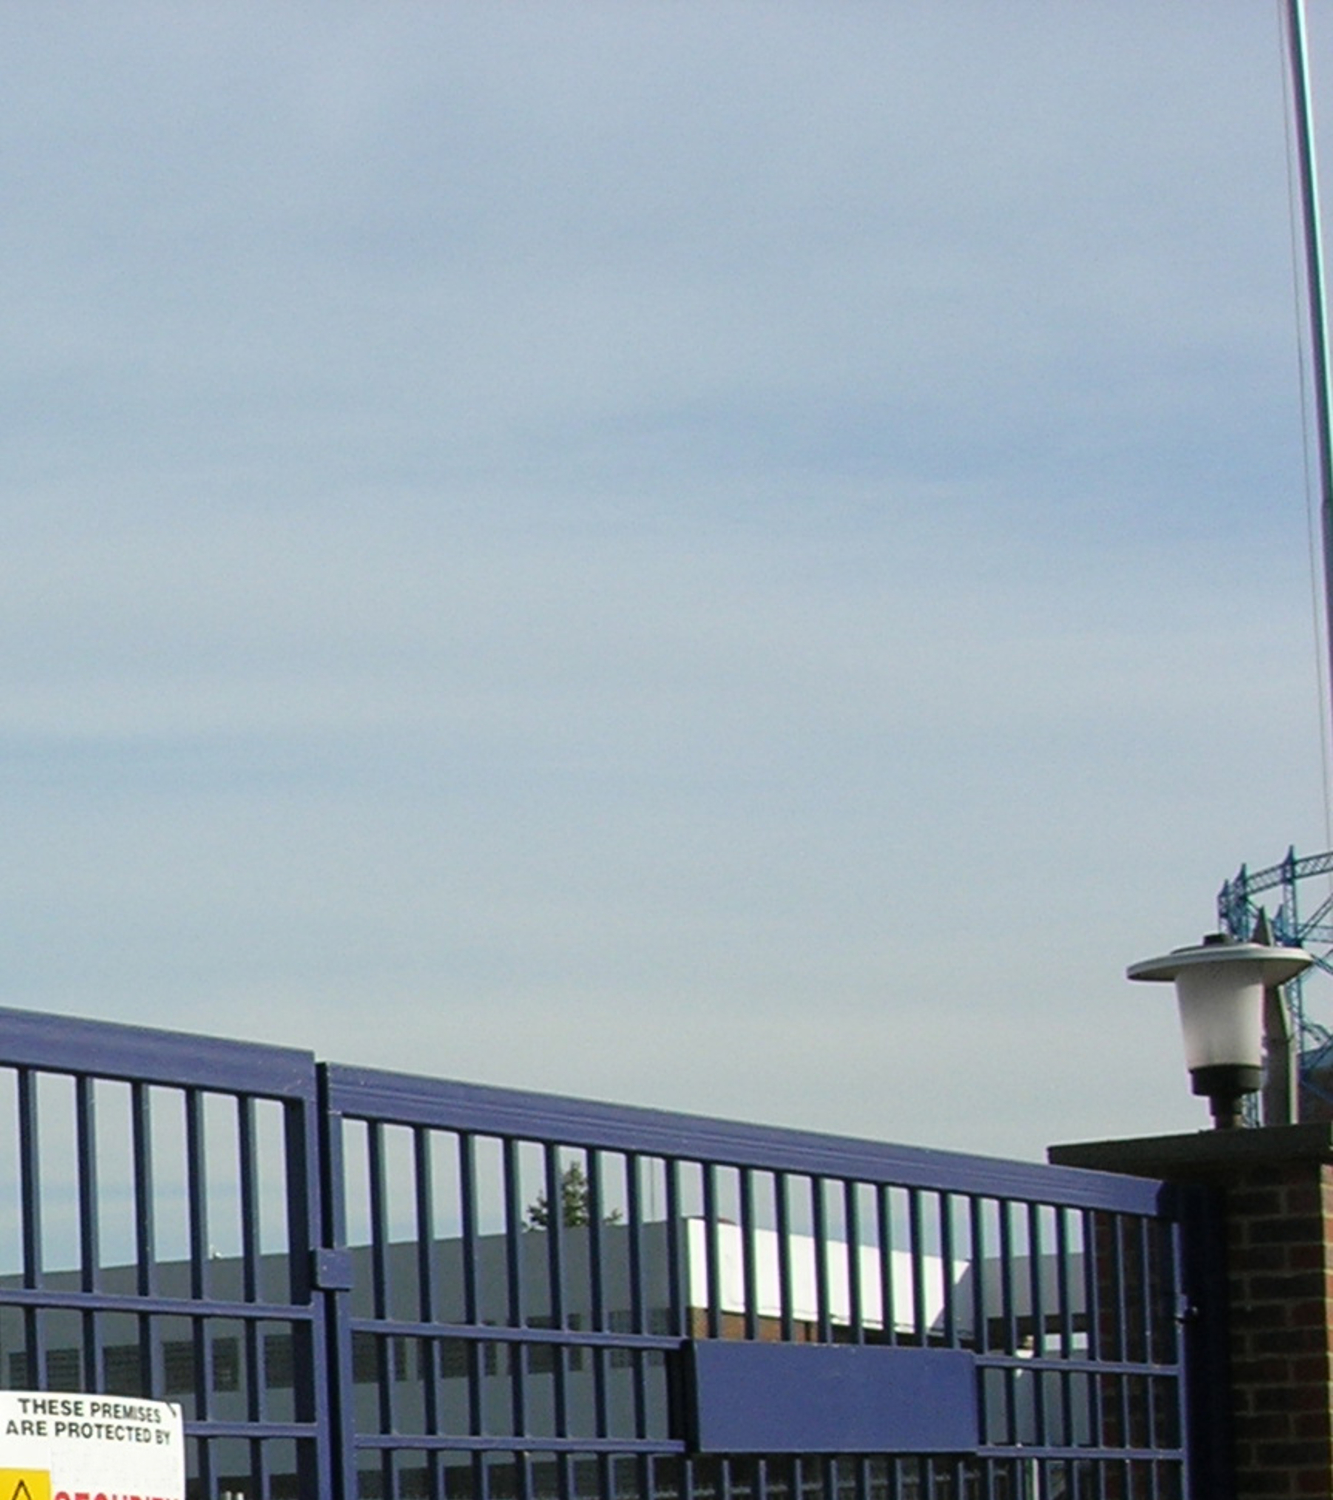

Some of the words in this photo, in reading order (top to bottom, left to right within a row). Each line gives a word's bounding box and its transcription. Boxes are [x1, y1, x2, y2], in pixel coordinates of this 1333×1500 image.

[17, 1398, 84, 1417] THESE
[90, 1402, 162, 1424] PREMISES
[6, 1420, 48, 1437] ARE
[54, 1422, 152, 1444] PROTECTED
[156, 1430, 171, 1445] BY
